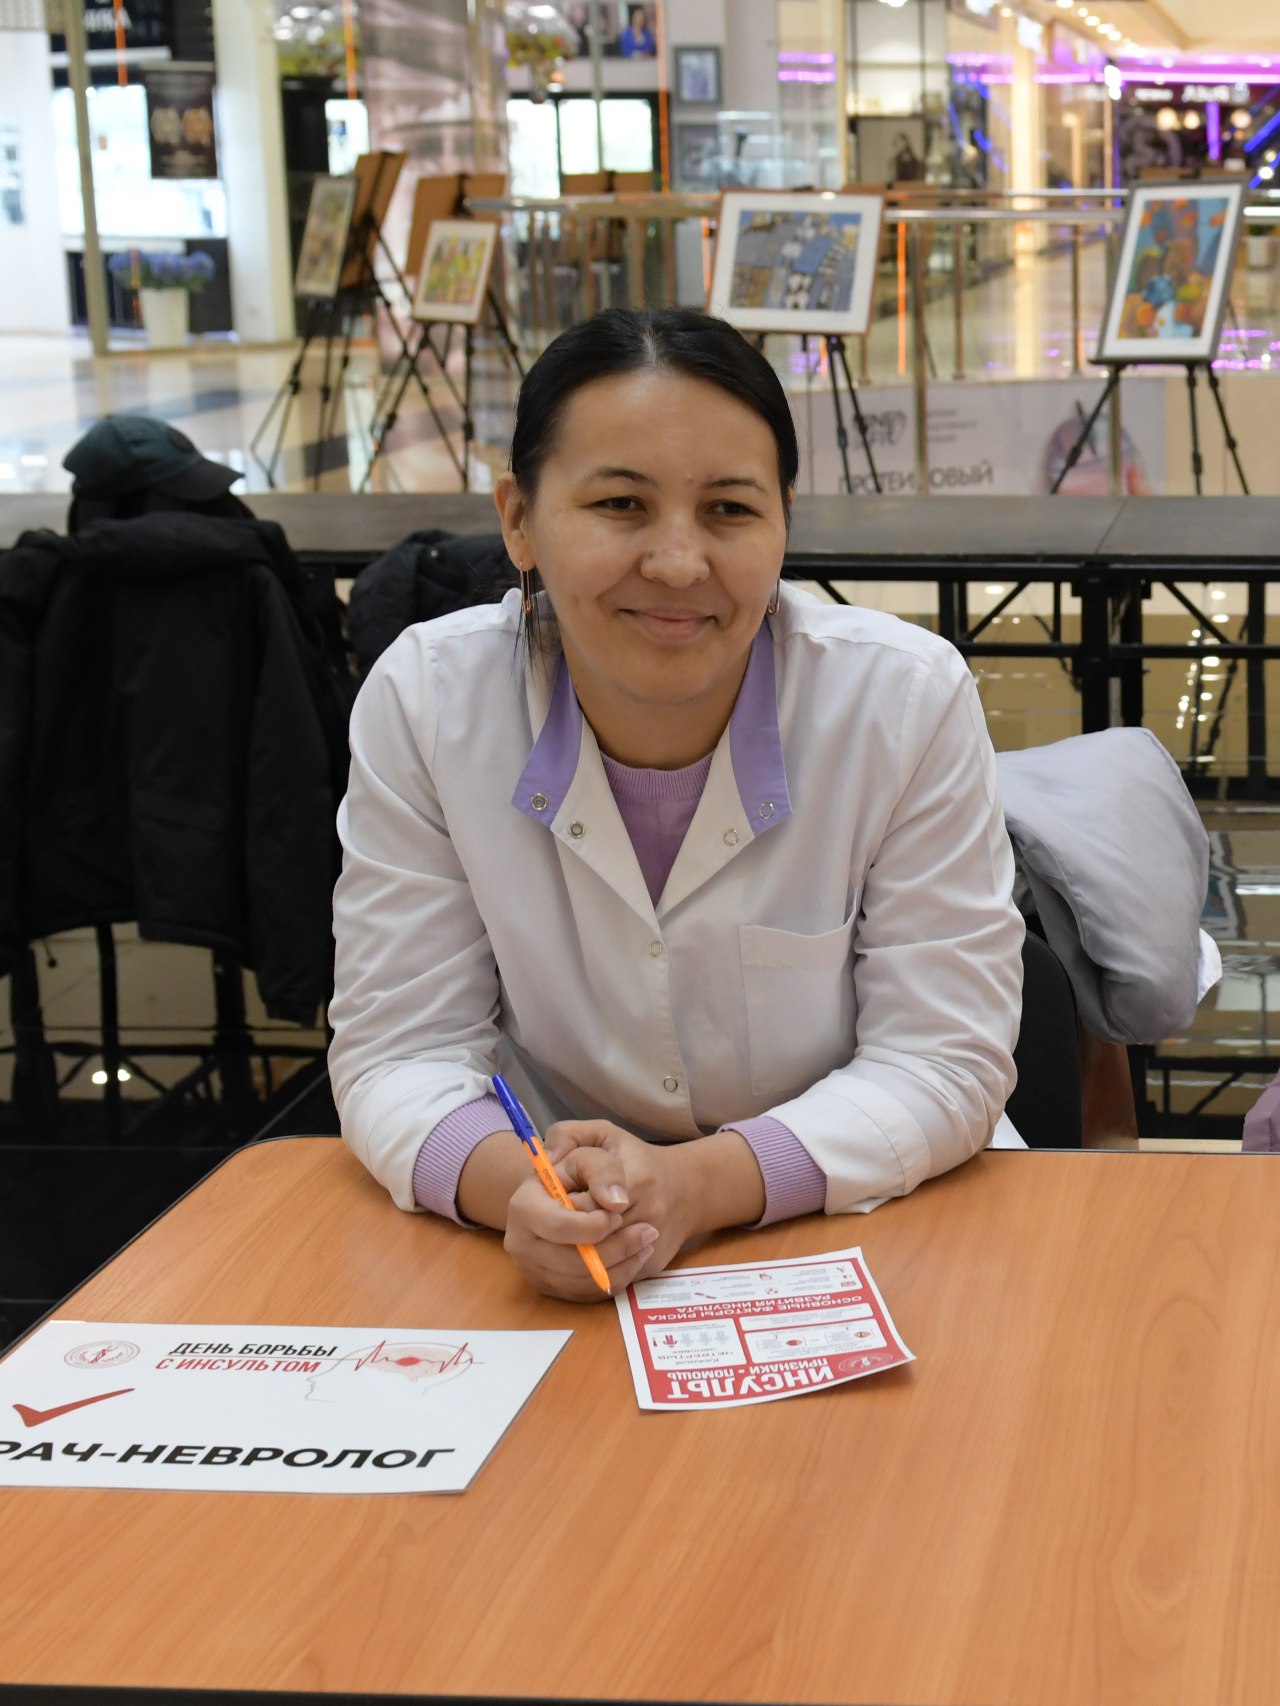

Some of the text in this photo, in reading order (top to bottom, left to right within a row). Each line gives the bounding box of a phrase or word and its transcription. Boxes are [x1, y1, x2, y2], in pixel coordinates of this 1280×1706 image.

[839, 458, 994, 493] ПРОТЕИОВЫЙ
[676, 1295, 831, 1313] РАЗВИТИЯ ИНСУЛЬТА
[778, 1296, 863, 1311] ОСНОВНЫЕ
[648, 1311, 697, 1321] РИСКА
[700, 1305, 776, 1318] ФАКТОРЫ
[169, 1343, 338, 1357] ДЕНЬ БОРЬБЫ
[155, 1358, 322, 1373] С ИНСУЛЬТОМ
[749, 1358, 830, 1375] ПРИЗНАКИ
[667, 1369, 734, 1380] ПОМОЩЬ
[667, 1369, 835, 1399] ИНСУЛЬТ
